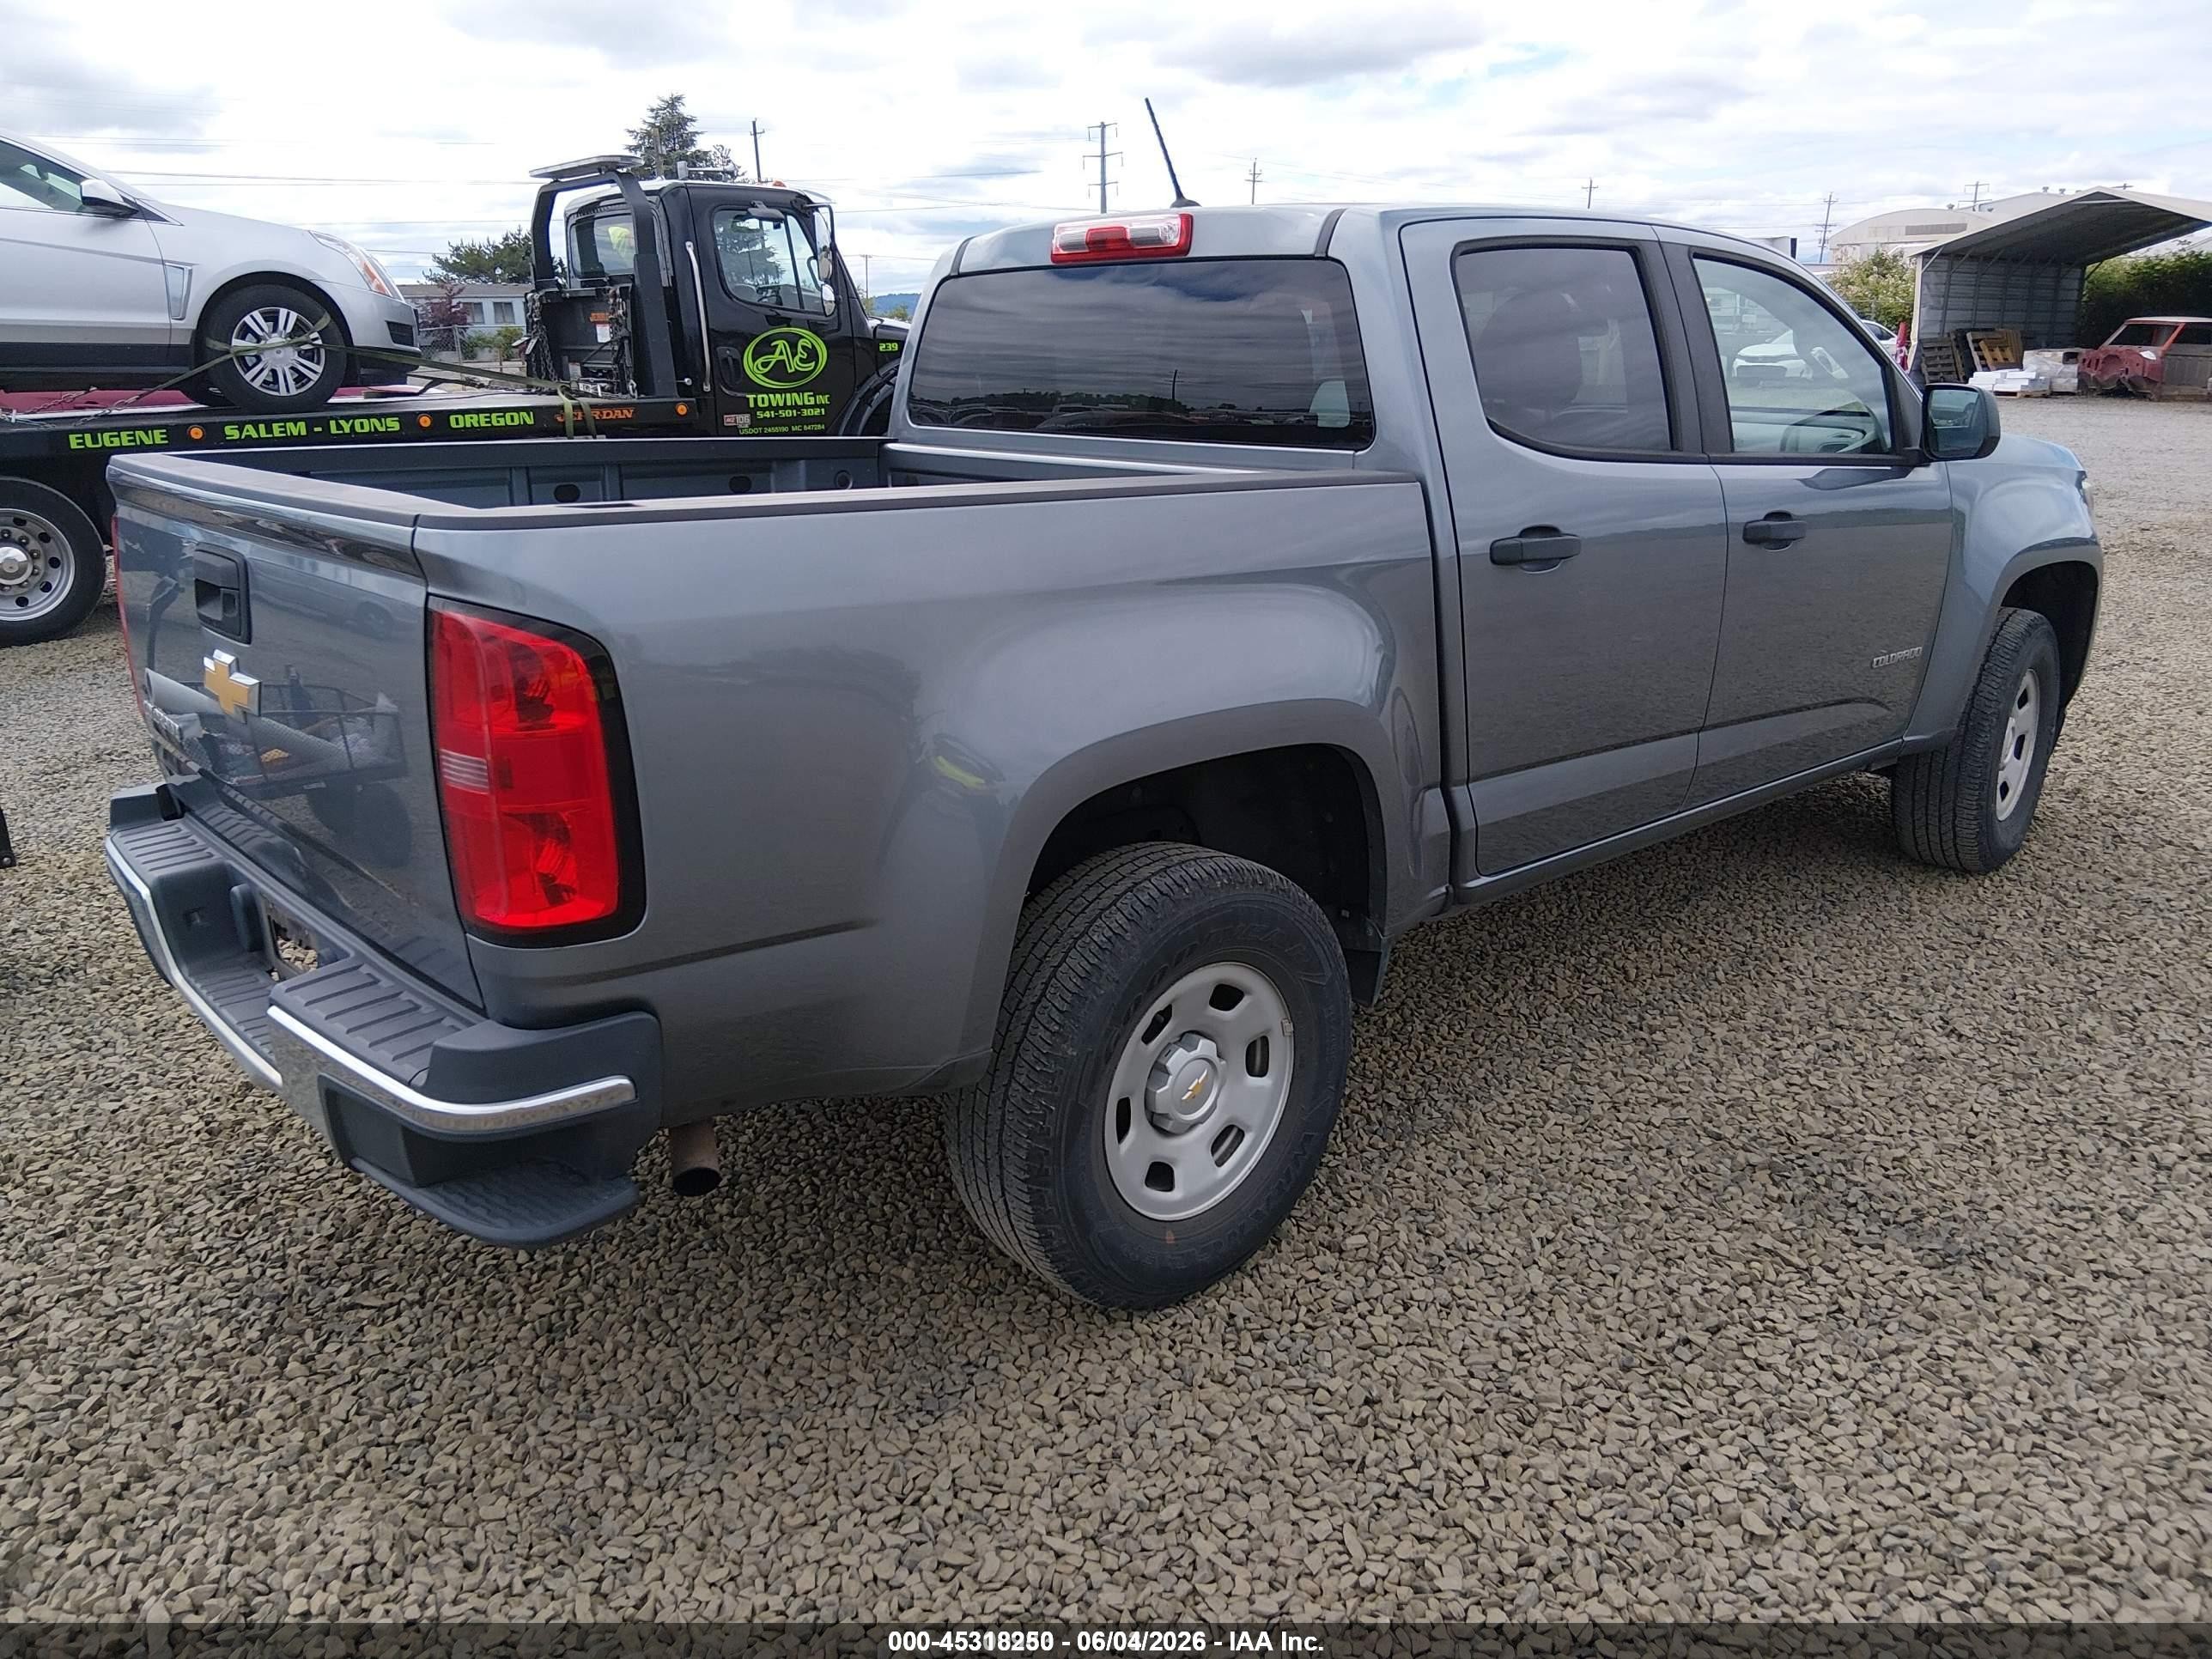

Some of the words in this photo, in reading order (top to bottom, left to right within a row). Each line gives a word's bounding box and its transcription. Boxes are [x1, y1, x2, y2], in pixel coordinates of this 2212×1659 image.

[878, 343, 899, 352] 239
[745, 392, 816, 408] TOWING
[816, 394, 830, 404] INC
[448, 411, 535, 428] OREGON
[757, 408, 825, 419] 541-501-3021
[224, 421, 307, 441] SALEM
[329, 416, 401, 434] LYONS
[68, 428, 168, 450] EUGENE
